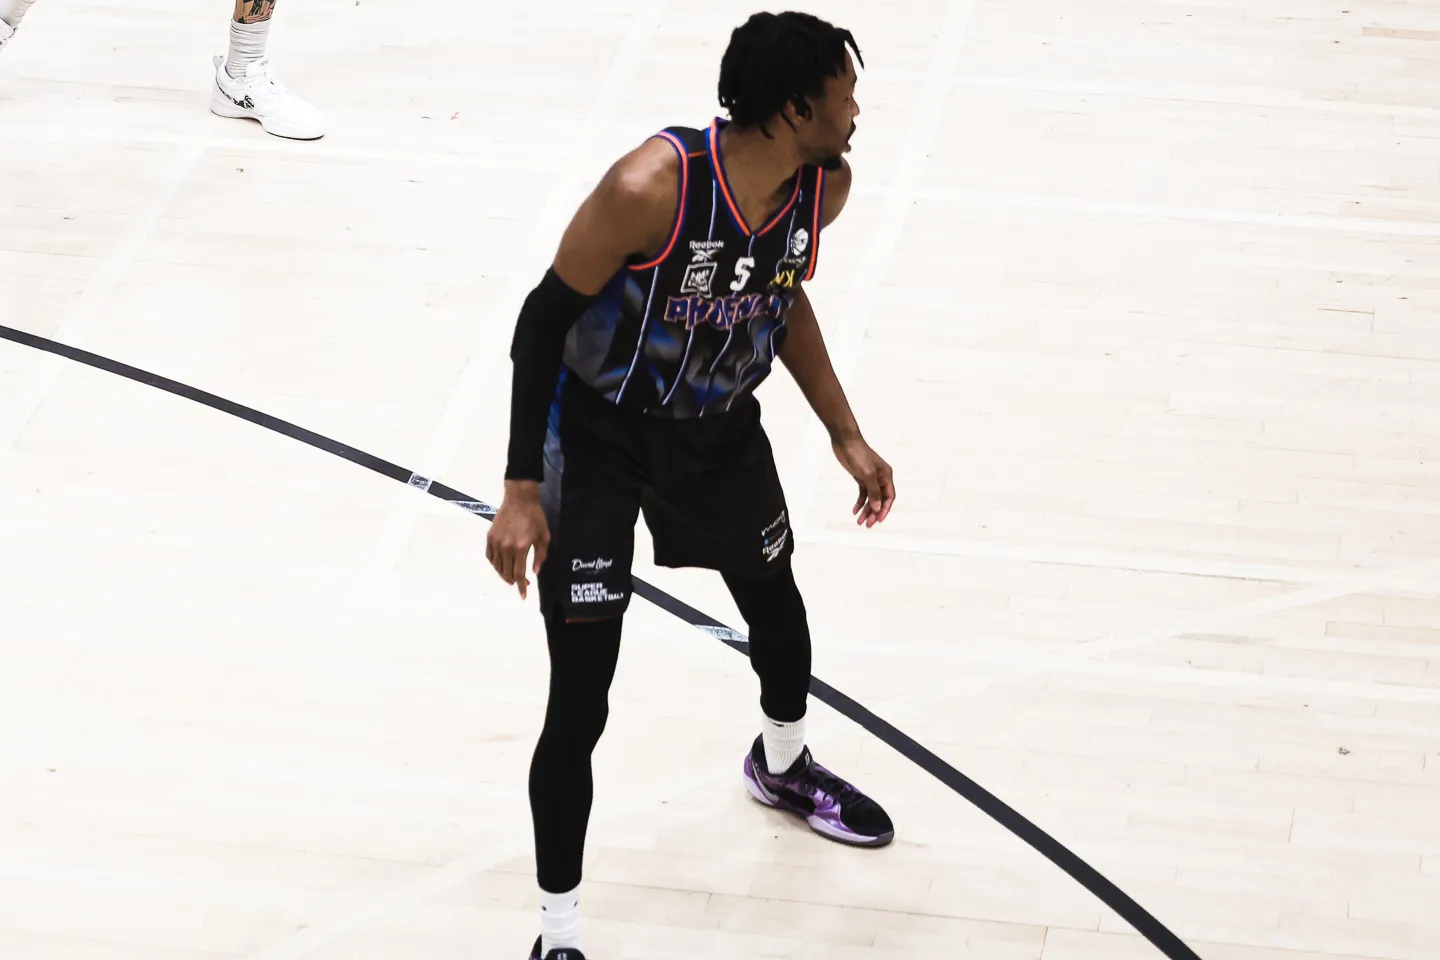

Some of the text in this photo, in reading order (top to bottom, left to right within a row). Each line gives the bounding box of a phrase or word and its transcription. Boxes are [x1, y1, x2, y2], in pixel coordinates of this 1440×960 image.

[689, 240, 724, 249] Reebok
[729, 256, 755, 292] 5
[571, 558, 596, 571] David
[571, 582, 603, 590] SUPER
[571, 588, 608, 596] LEAGUE
